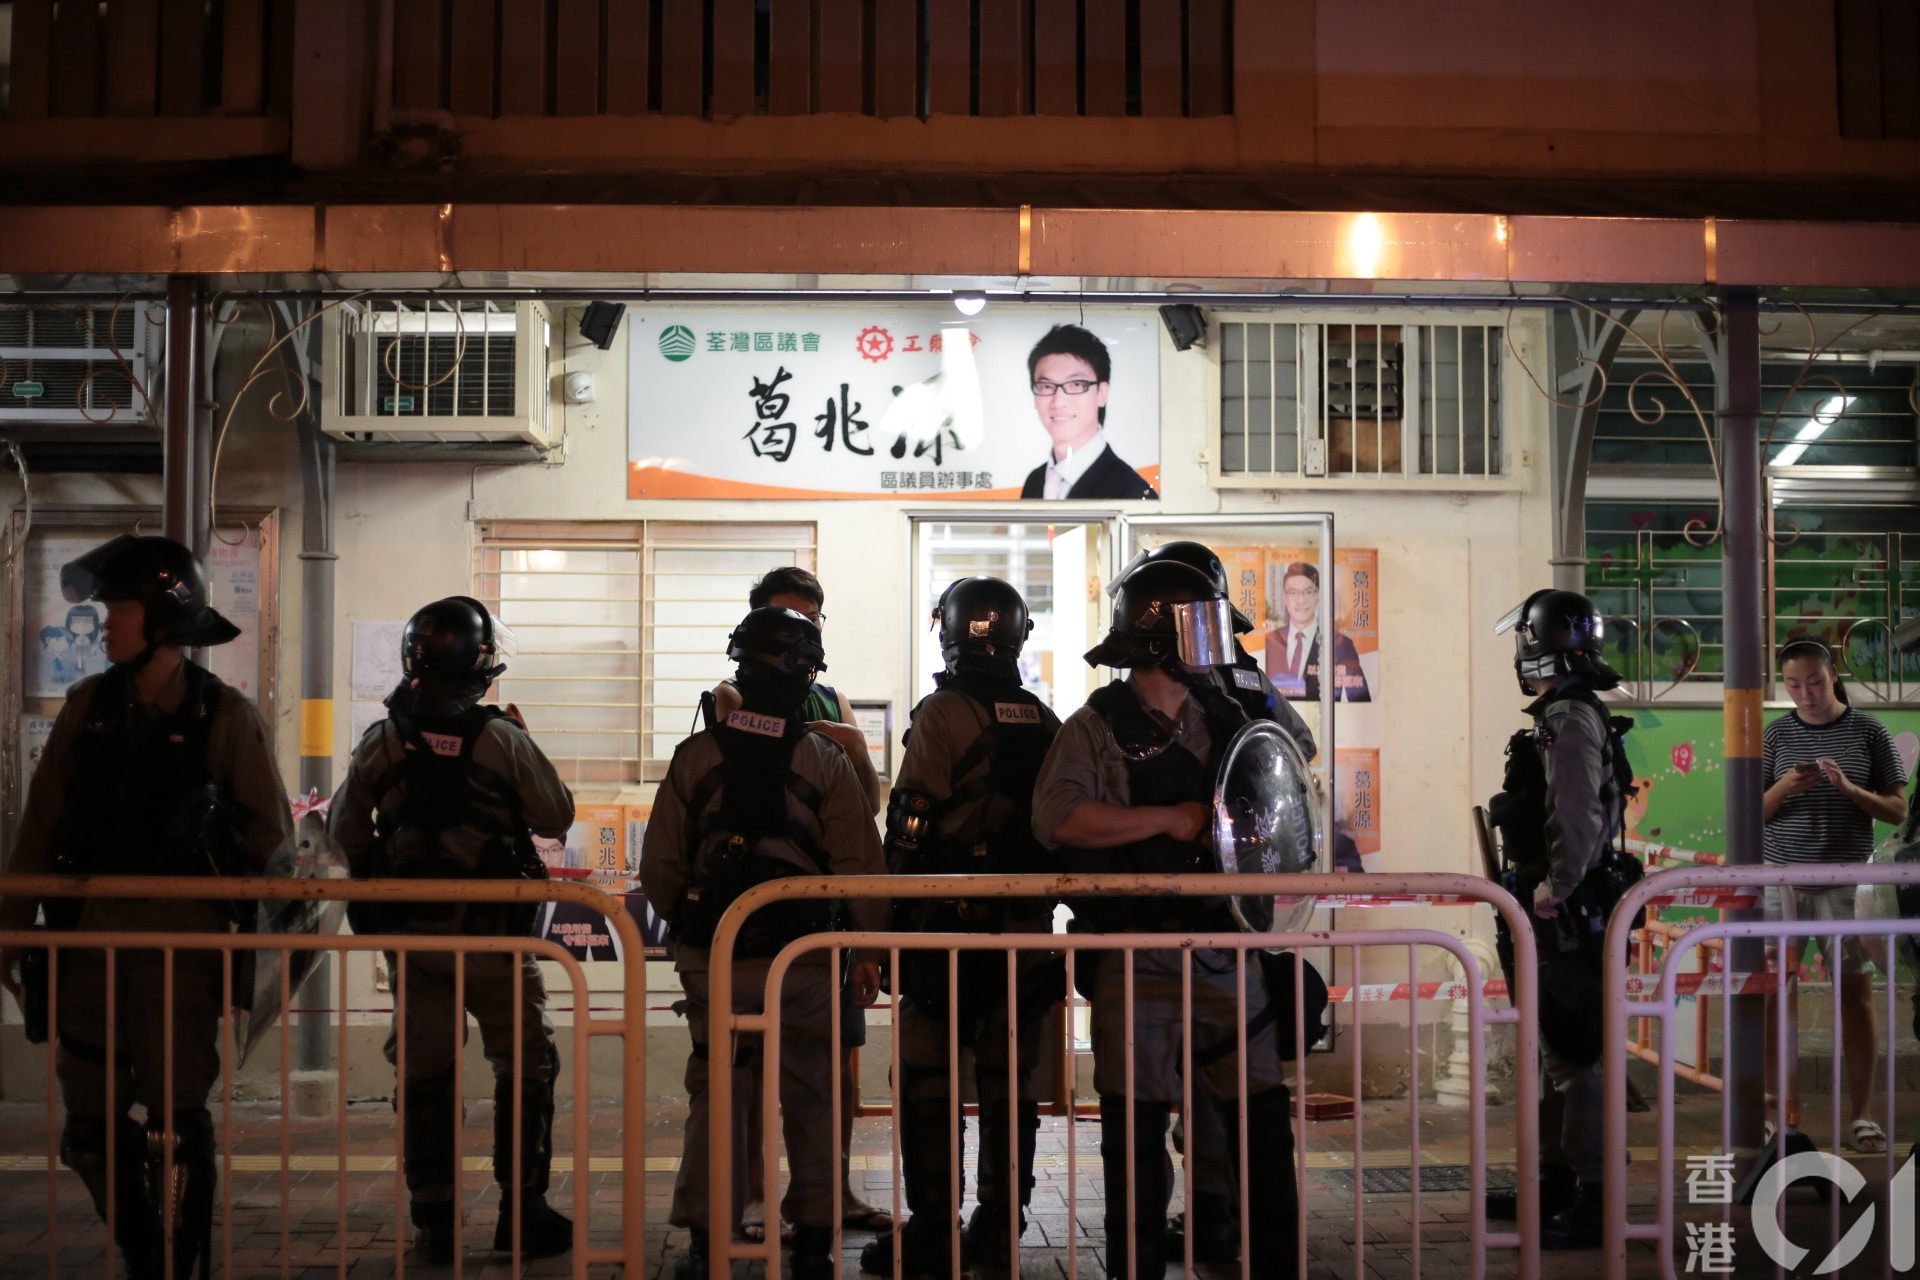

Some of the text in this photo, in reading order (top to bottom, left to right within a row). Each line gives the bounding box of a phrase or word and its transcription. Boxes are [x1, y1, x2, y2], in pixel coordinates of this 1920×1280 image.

[706, 331, 820, 352] 荃灣區議會
[881, 471, 992, 489] 區議員辦事處
[1353, 570, 1369, 628] 葛兆源
[731, 711, 781, 734] POLICE
[1000, 707, 1036, 720] POLICE
[426, 738, 457, 752] LICE
[1355, 770, 1371, 829] 葛兆源
[1290, 793, 1311, 864] POLICE
